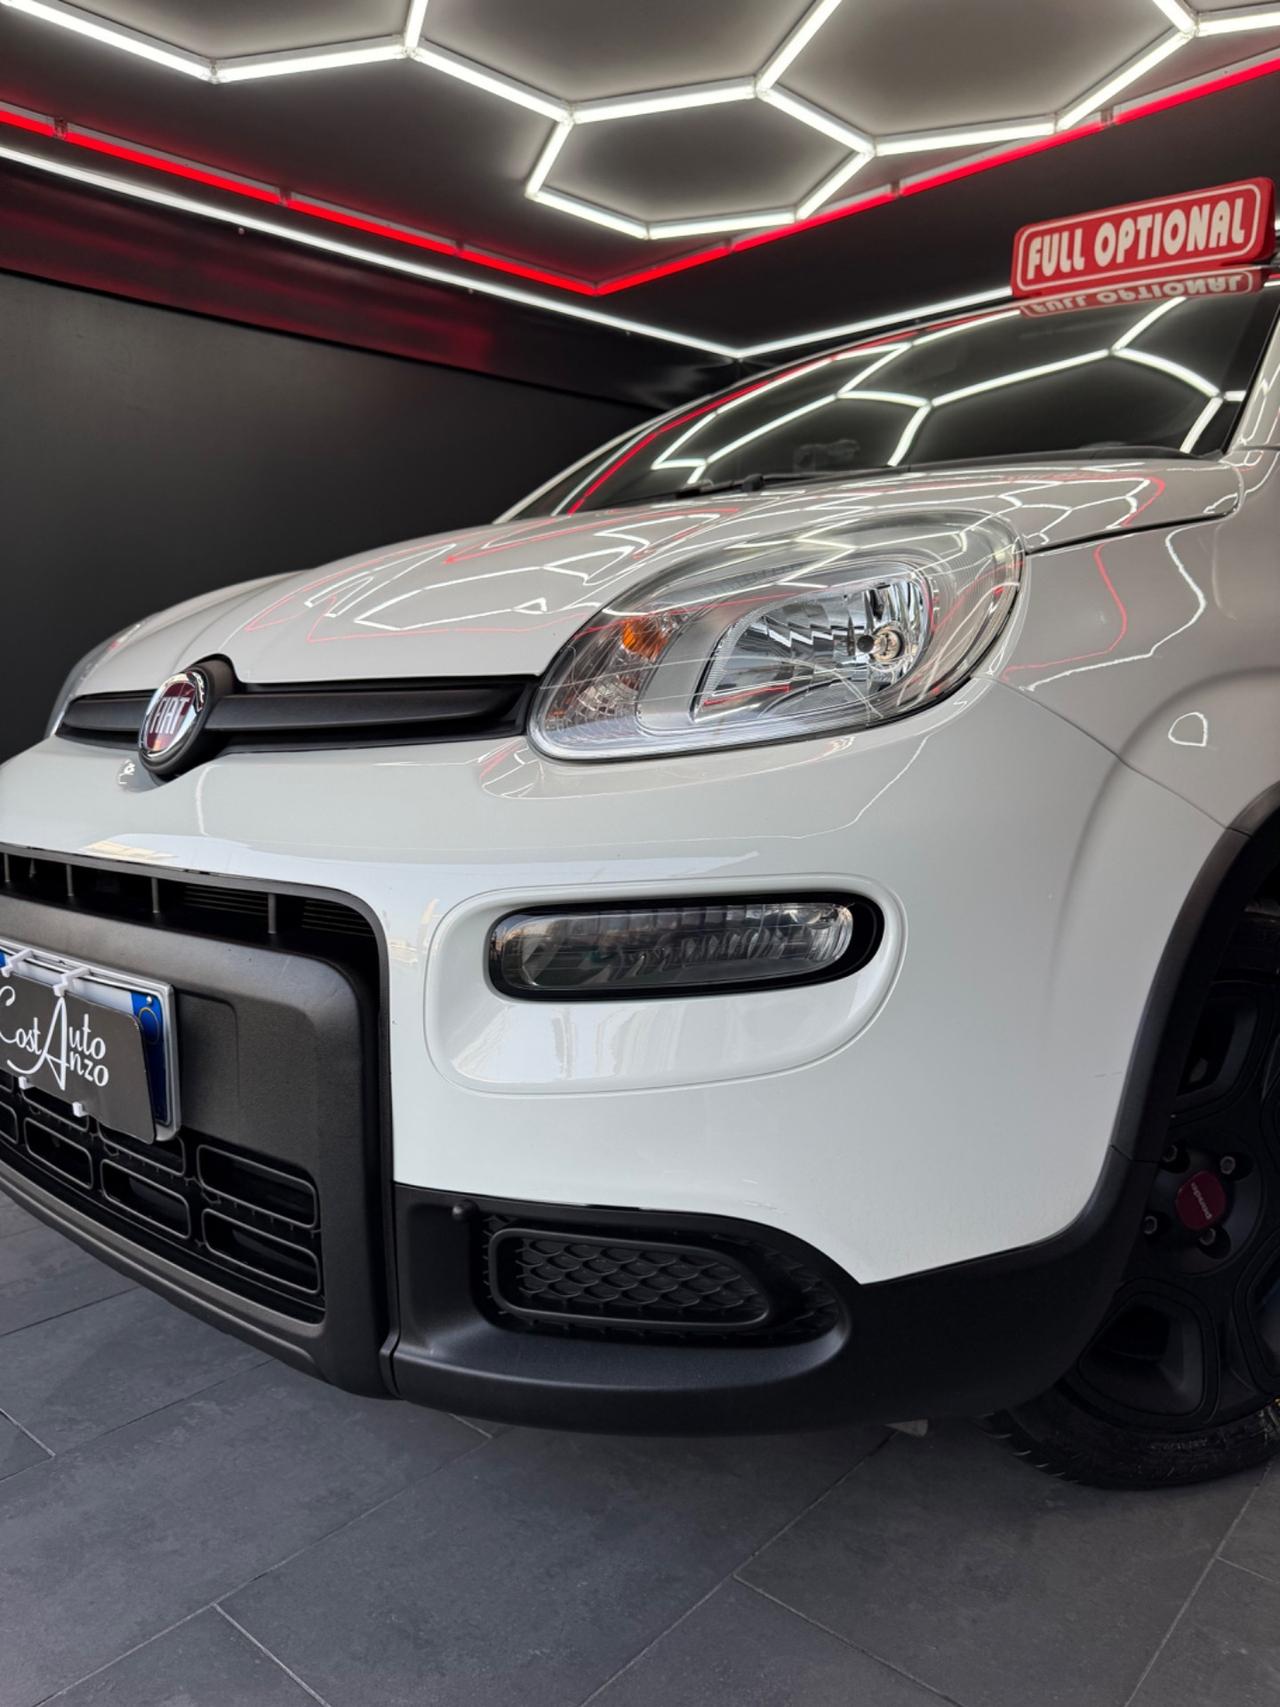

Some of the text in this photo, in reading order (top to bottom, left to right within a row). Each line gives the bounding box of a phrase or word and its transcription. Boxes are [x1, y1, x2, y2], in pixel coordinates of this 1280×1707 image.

[1026, 198, 1245, 280] FULL OPTIONAL
[149, 697, 190, 734] FIAT
